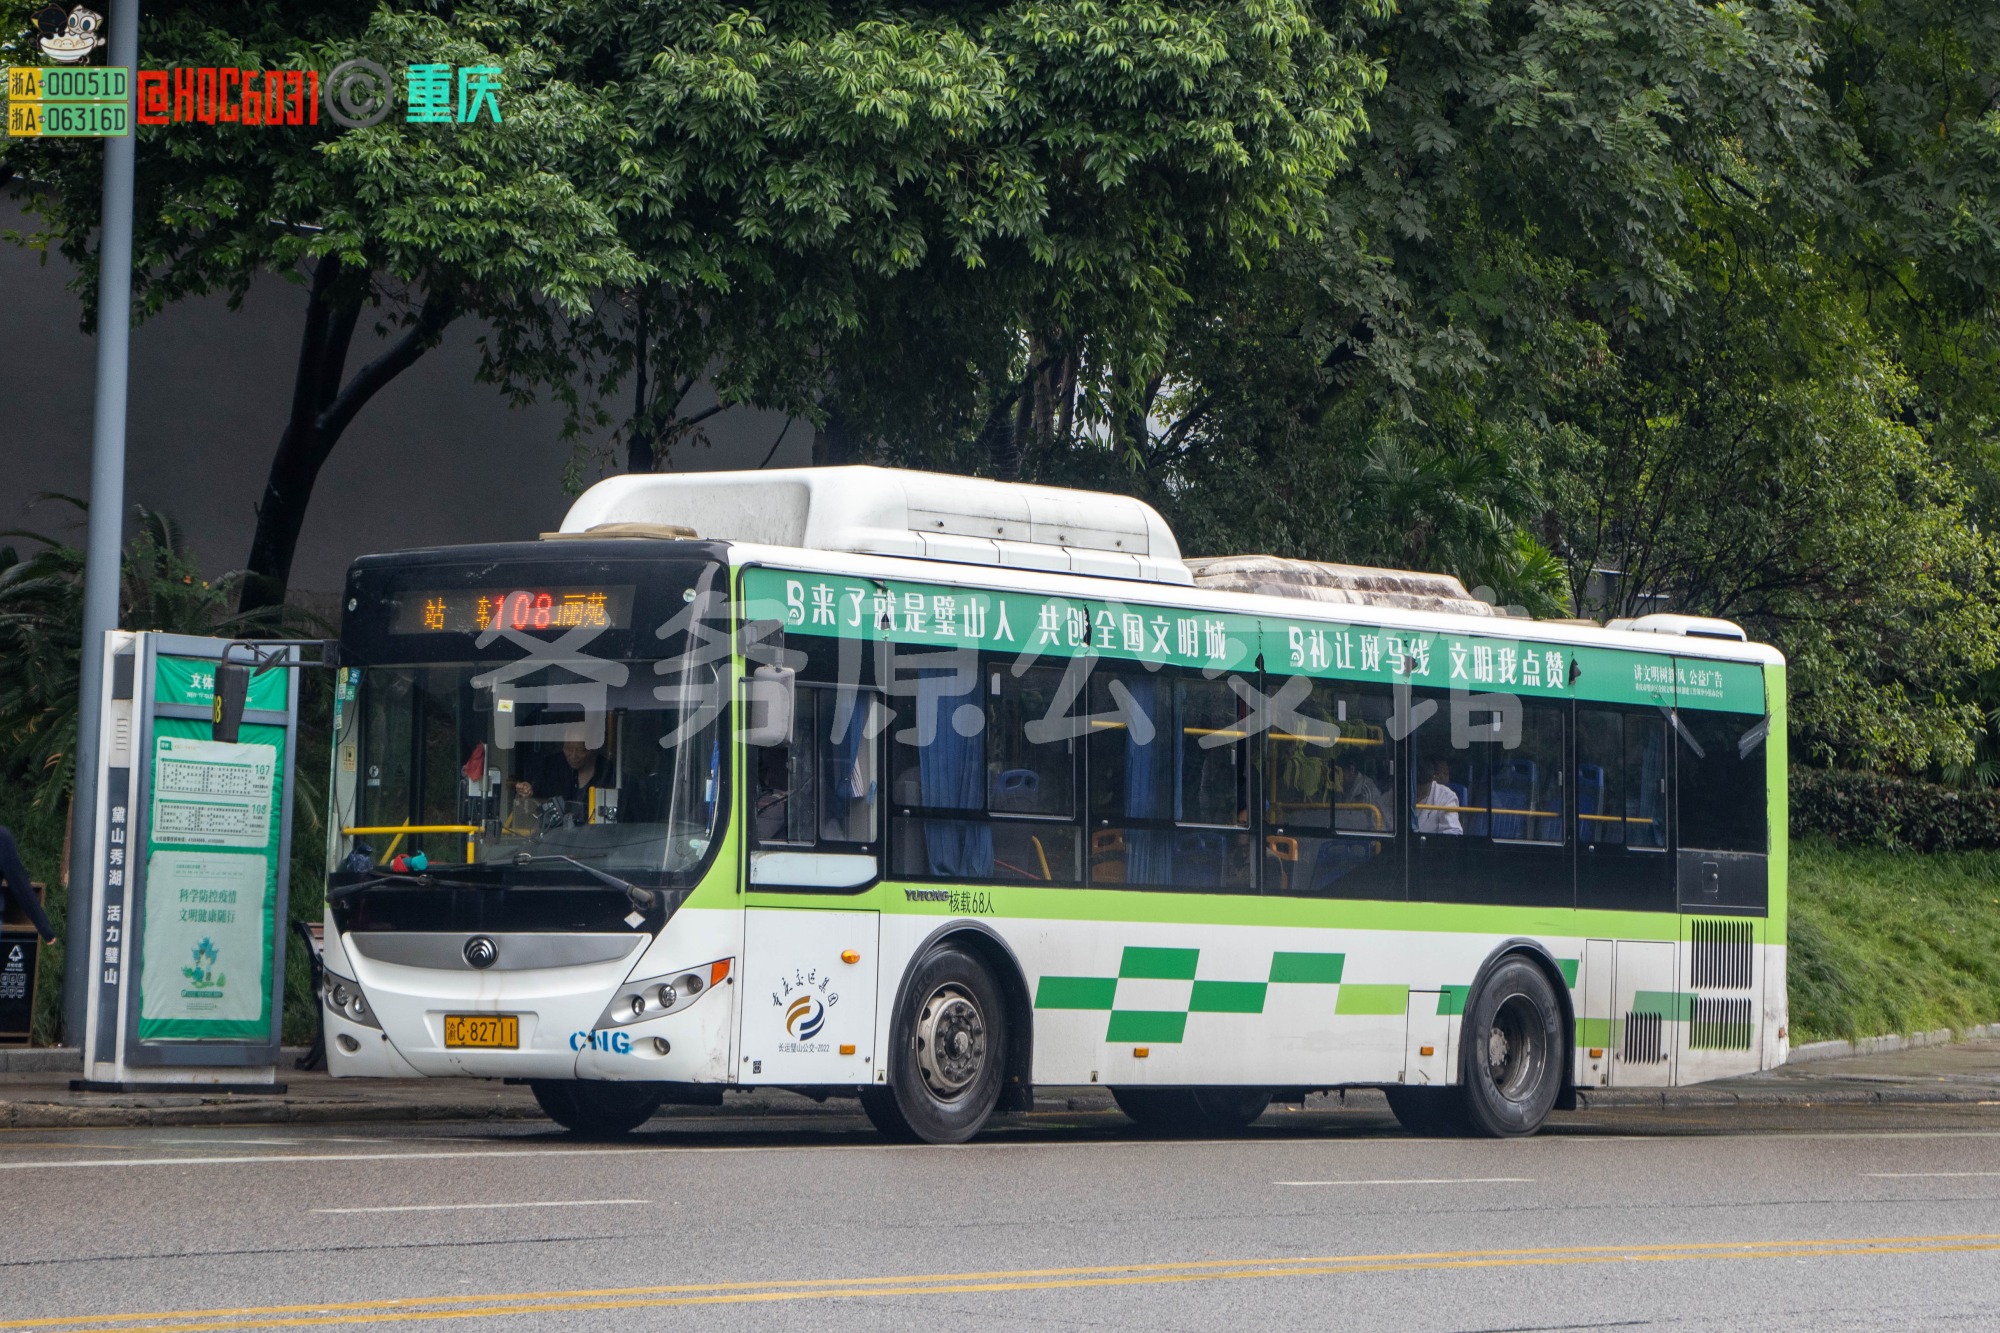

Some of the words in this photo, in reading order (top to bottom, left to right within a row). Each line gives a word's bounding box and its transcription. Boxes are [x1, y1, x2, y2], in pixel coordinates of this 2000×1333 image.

[496, 594, 551, 630] 108
[811, 583, 1015, 642] 来了就是璧山人
[1039, 604, 1226, 660] 共创全国文明城
[1309, 629, 1430, 677] 礼让斑马线
[1449, 642, 1564, 690] 文明我点赞
[190, 672, 215, 690] 文体
[1689, 669, 1723, 688] 公益广告
[109, 806, 126, 886] 黛山秀湖
[904, 887, 950, 902] YUTONG
[949, 889, 995, 914] 核载68人
[103, 905, 121, 985] 活力璧山
[569, 1030, 634, 1055] CNG
